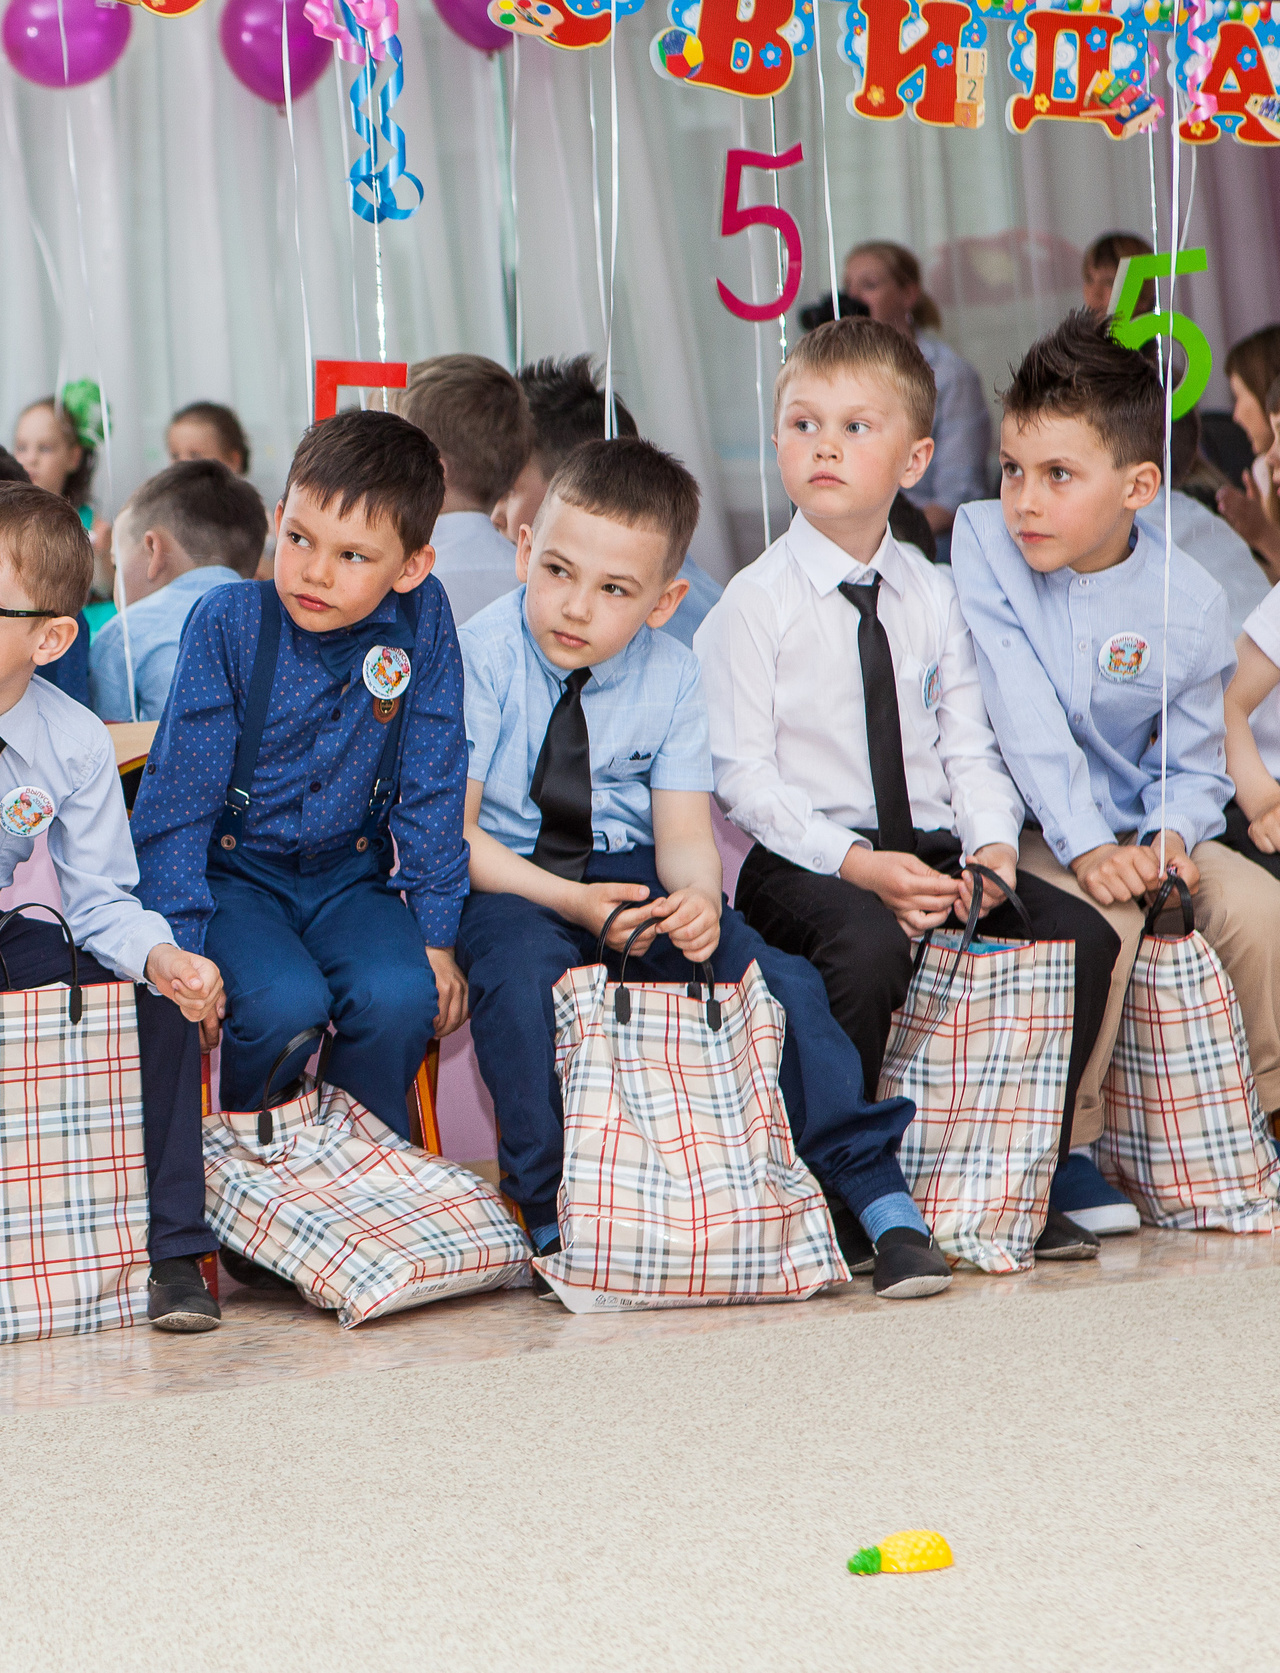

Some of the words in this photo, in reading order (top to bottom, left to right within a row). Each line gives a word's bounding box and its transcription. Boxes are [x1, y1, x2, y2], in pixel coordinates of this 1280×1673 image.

[522, 0, 1280, 146] ВИДА
[716, 142, 804, 323] 5
[1109, 247, 1214, 423] 5
